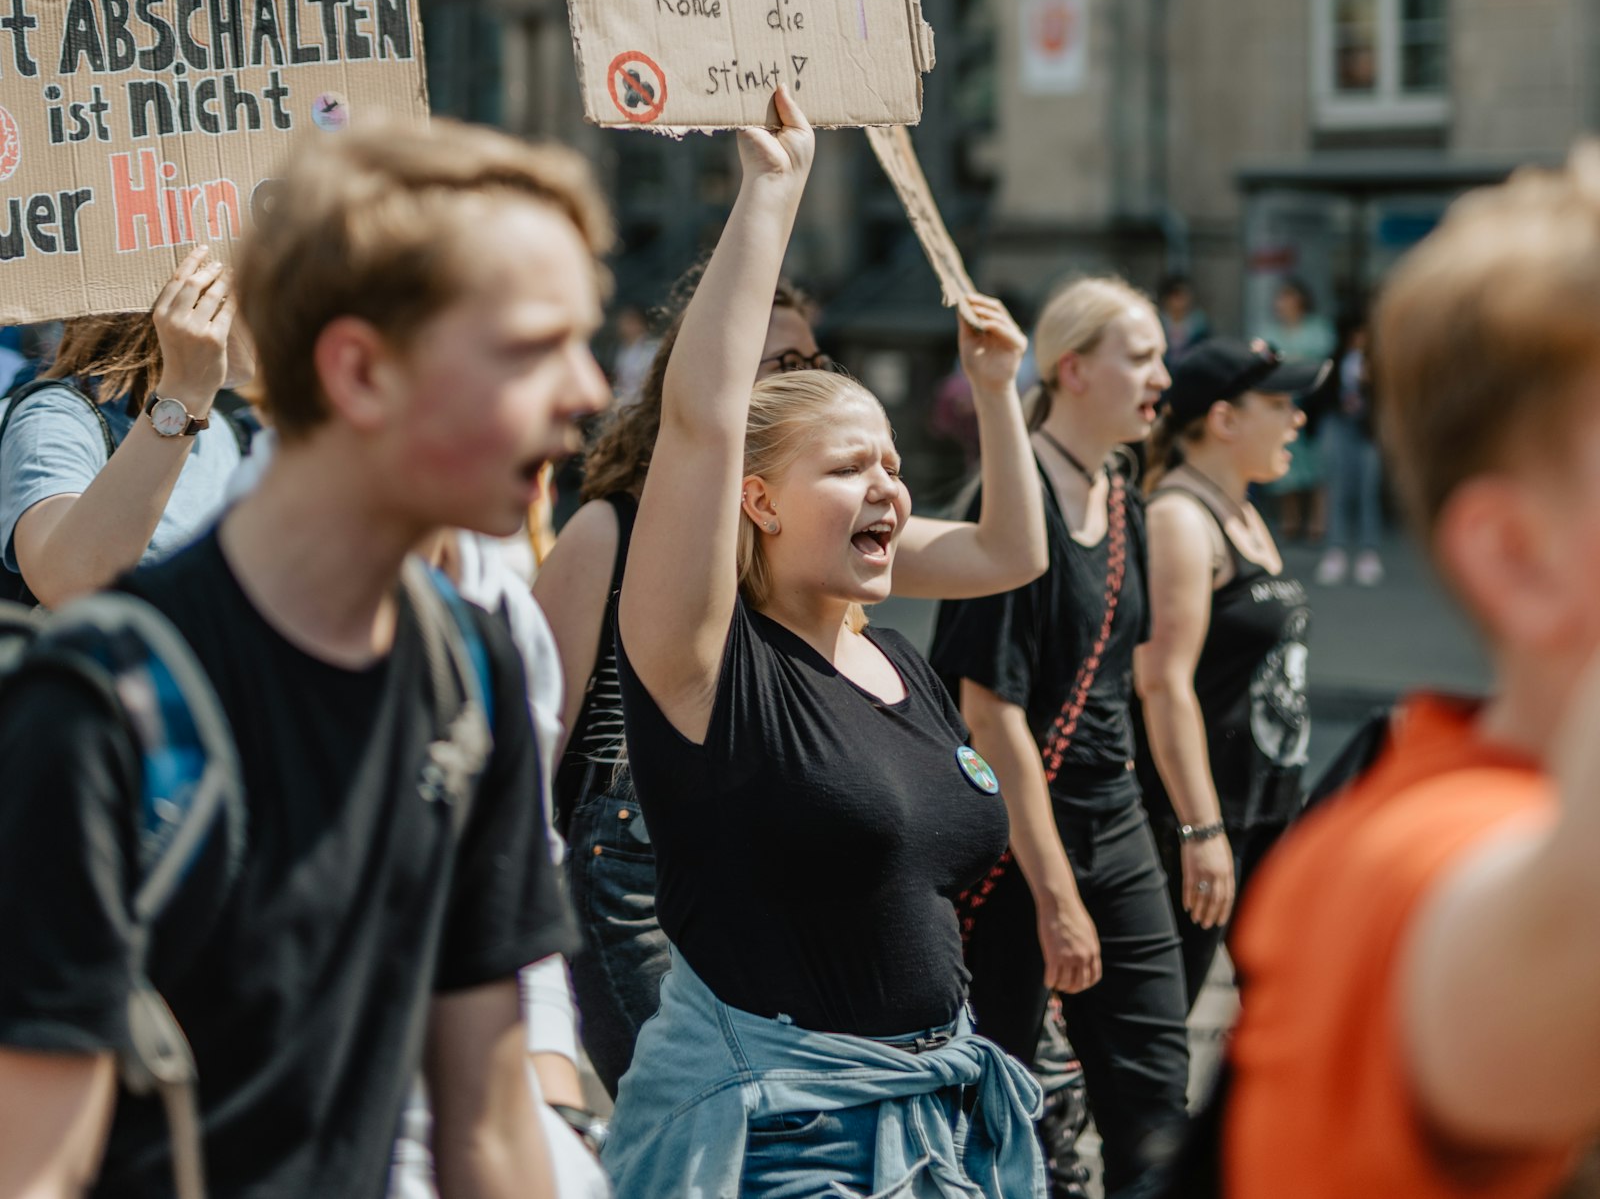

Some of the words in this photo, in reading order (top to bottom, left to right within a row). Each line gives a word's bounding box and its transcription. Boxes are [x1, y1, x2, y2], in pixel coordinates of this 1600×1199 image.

[45, 84, 112, 144] ist
[126, 61, 292, 140] nicht
[109, 148, 241, 253] Hirn
